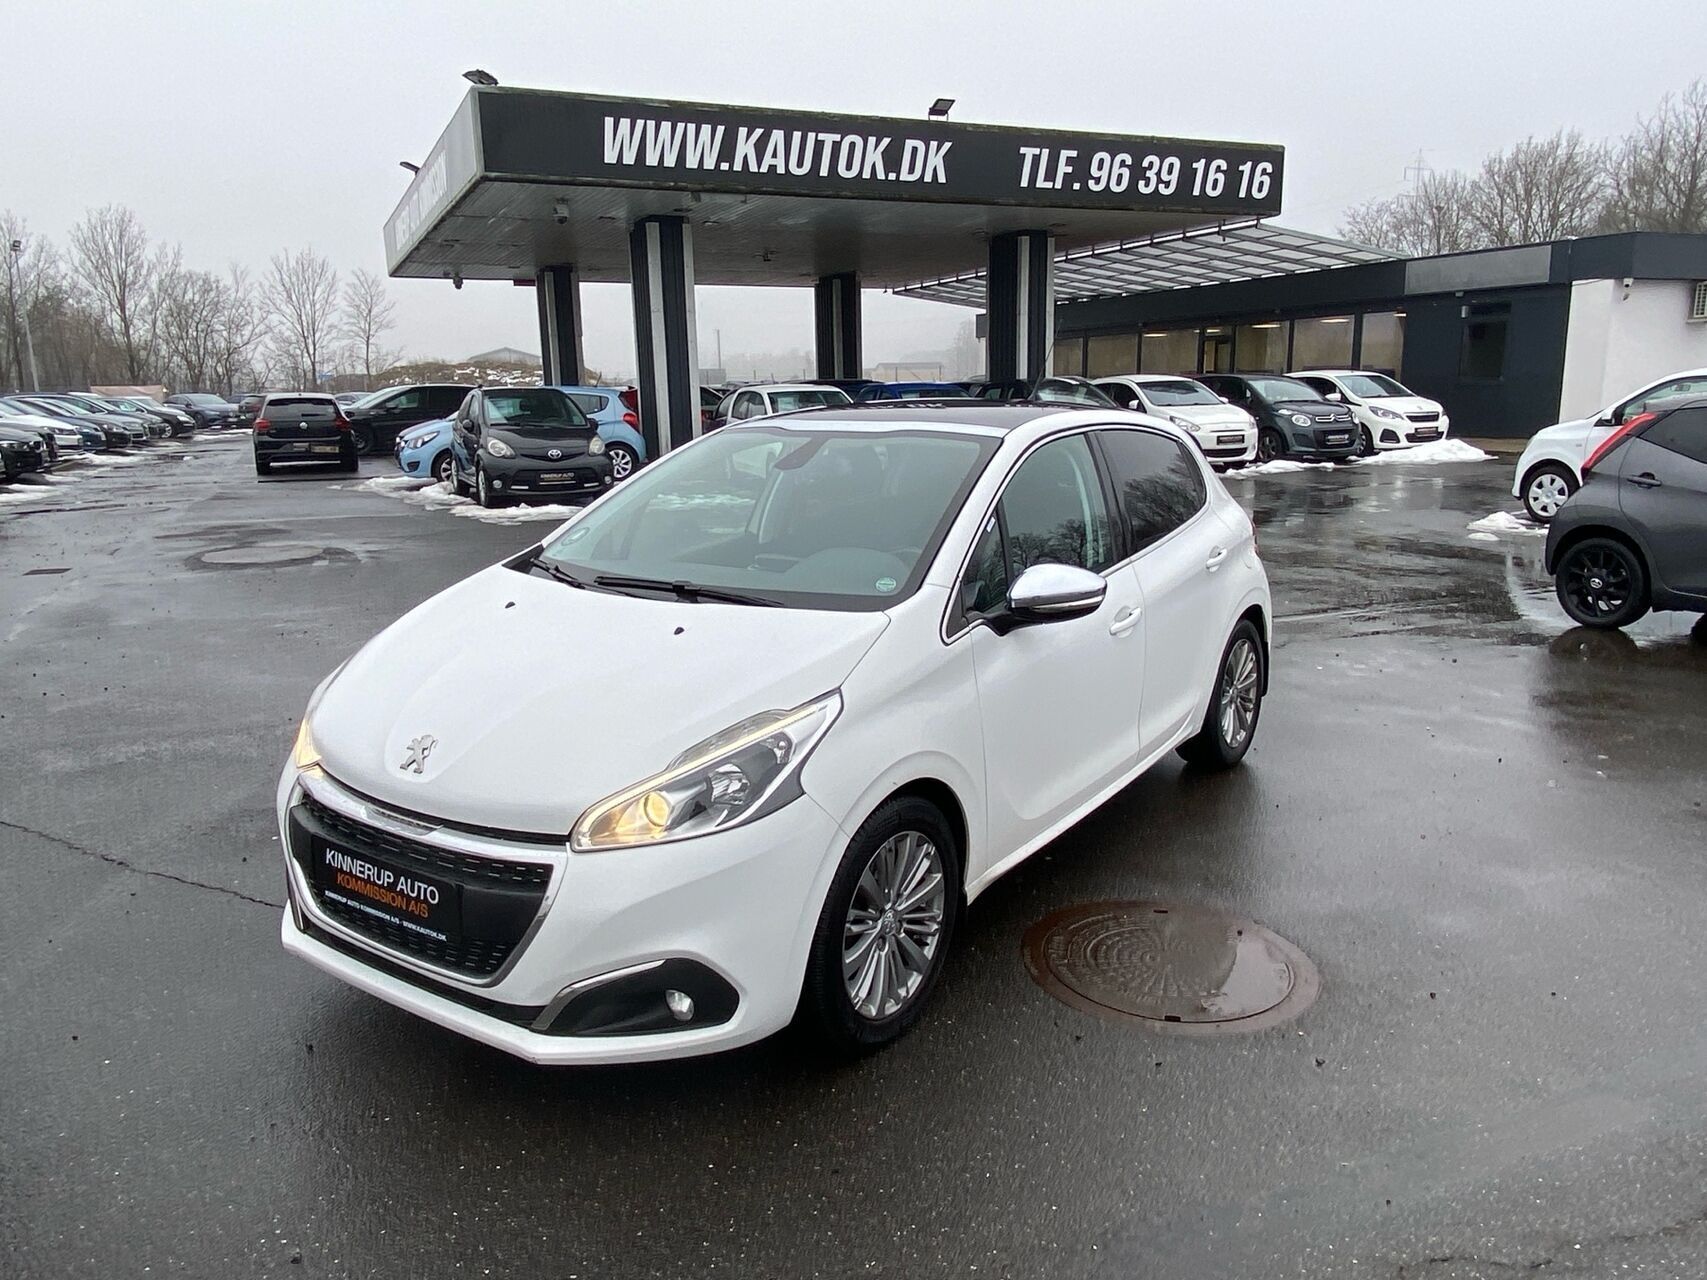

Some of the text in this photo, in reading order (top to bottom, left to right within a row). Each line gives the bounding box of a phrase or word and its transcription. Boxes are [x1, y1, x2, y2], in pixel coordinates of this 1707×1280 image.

[602, 115, 954, 185] WWW.KAUTOK.DK
[1018, 146, 1274, 201] TLF. 96 39 16 16
[325, 847, 440, 905] KINNERUP AUTO
[337, 872, 429, 919] KOMMISSION A/S
